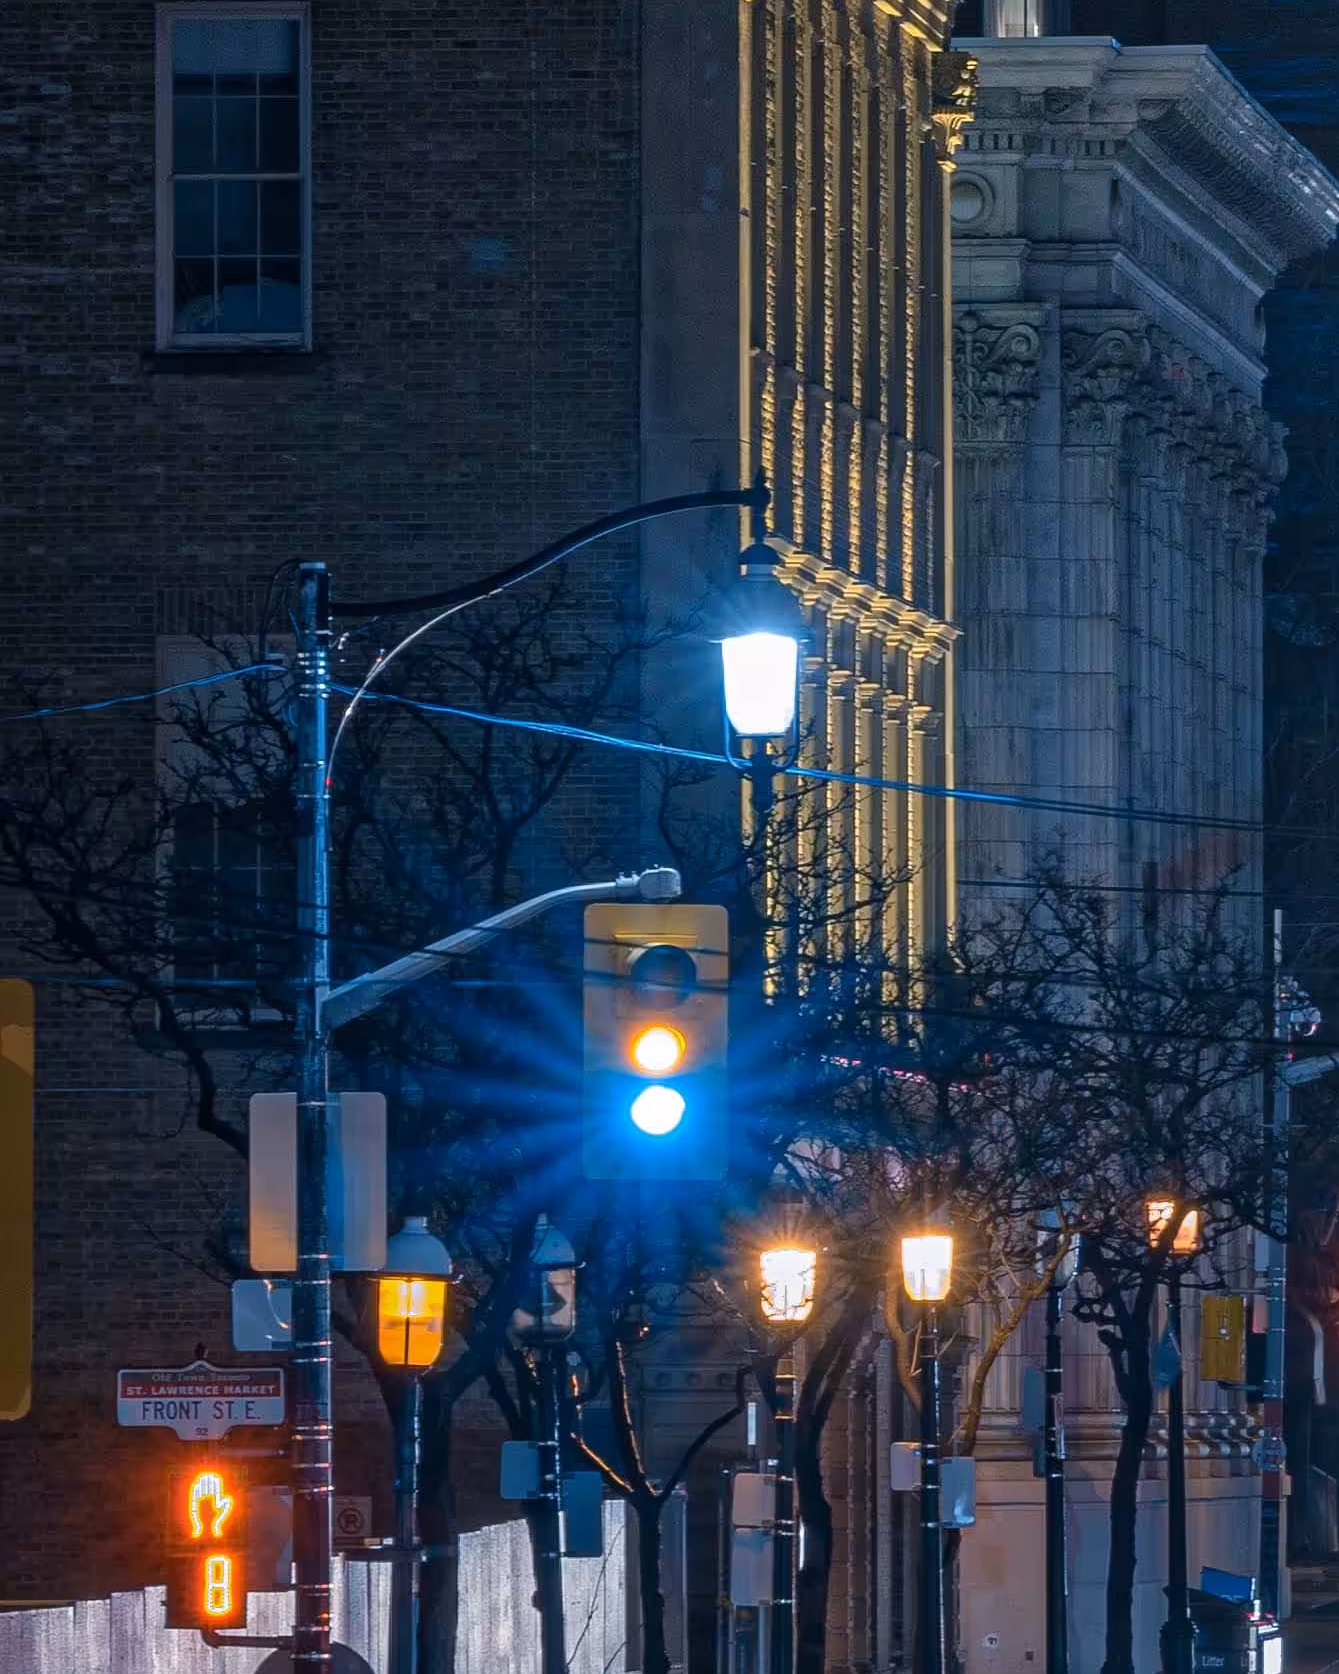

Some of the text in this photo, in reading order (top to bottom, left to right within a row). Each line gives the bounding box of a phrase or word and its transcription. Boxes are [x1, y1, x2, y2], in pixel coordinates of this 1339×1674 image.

[126, 1384, 276, 1396] ST. LAWRENCE MARKET
[142, 1401, 203, 1420] FRONT
[245, 1401, 261, 1420] E.
